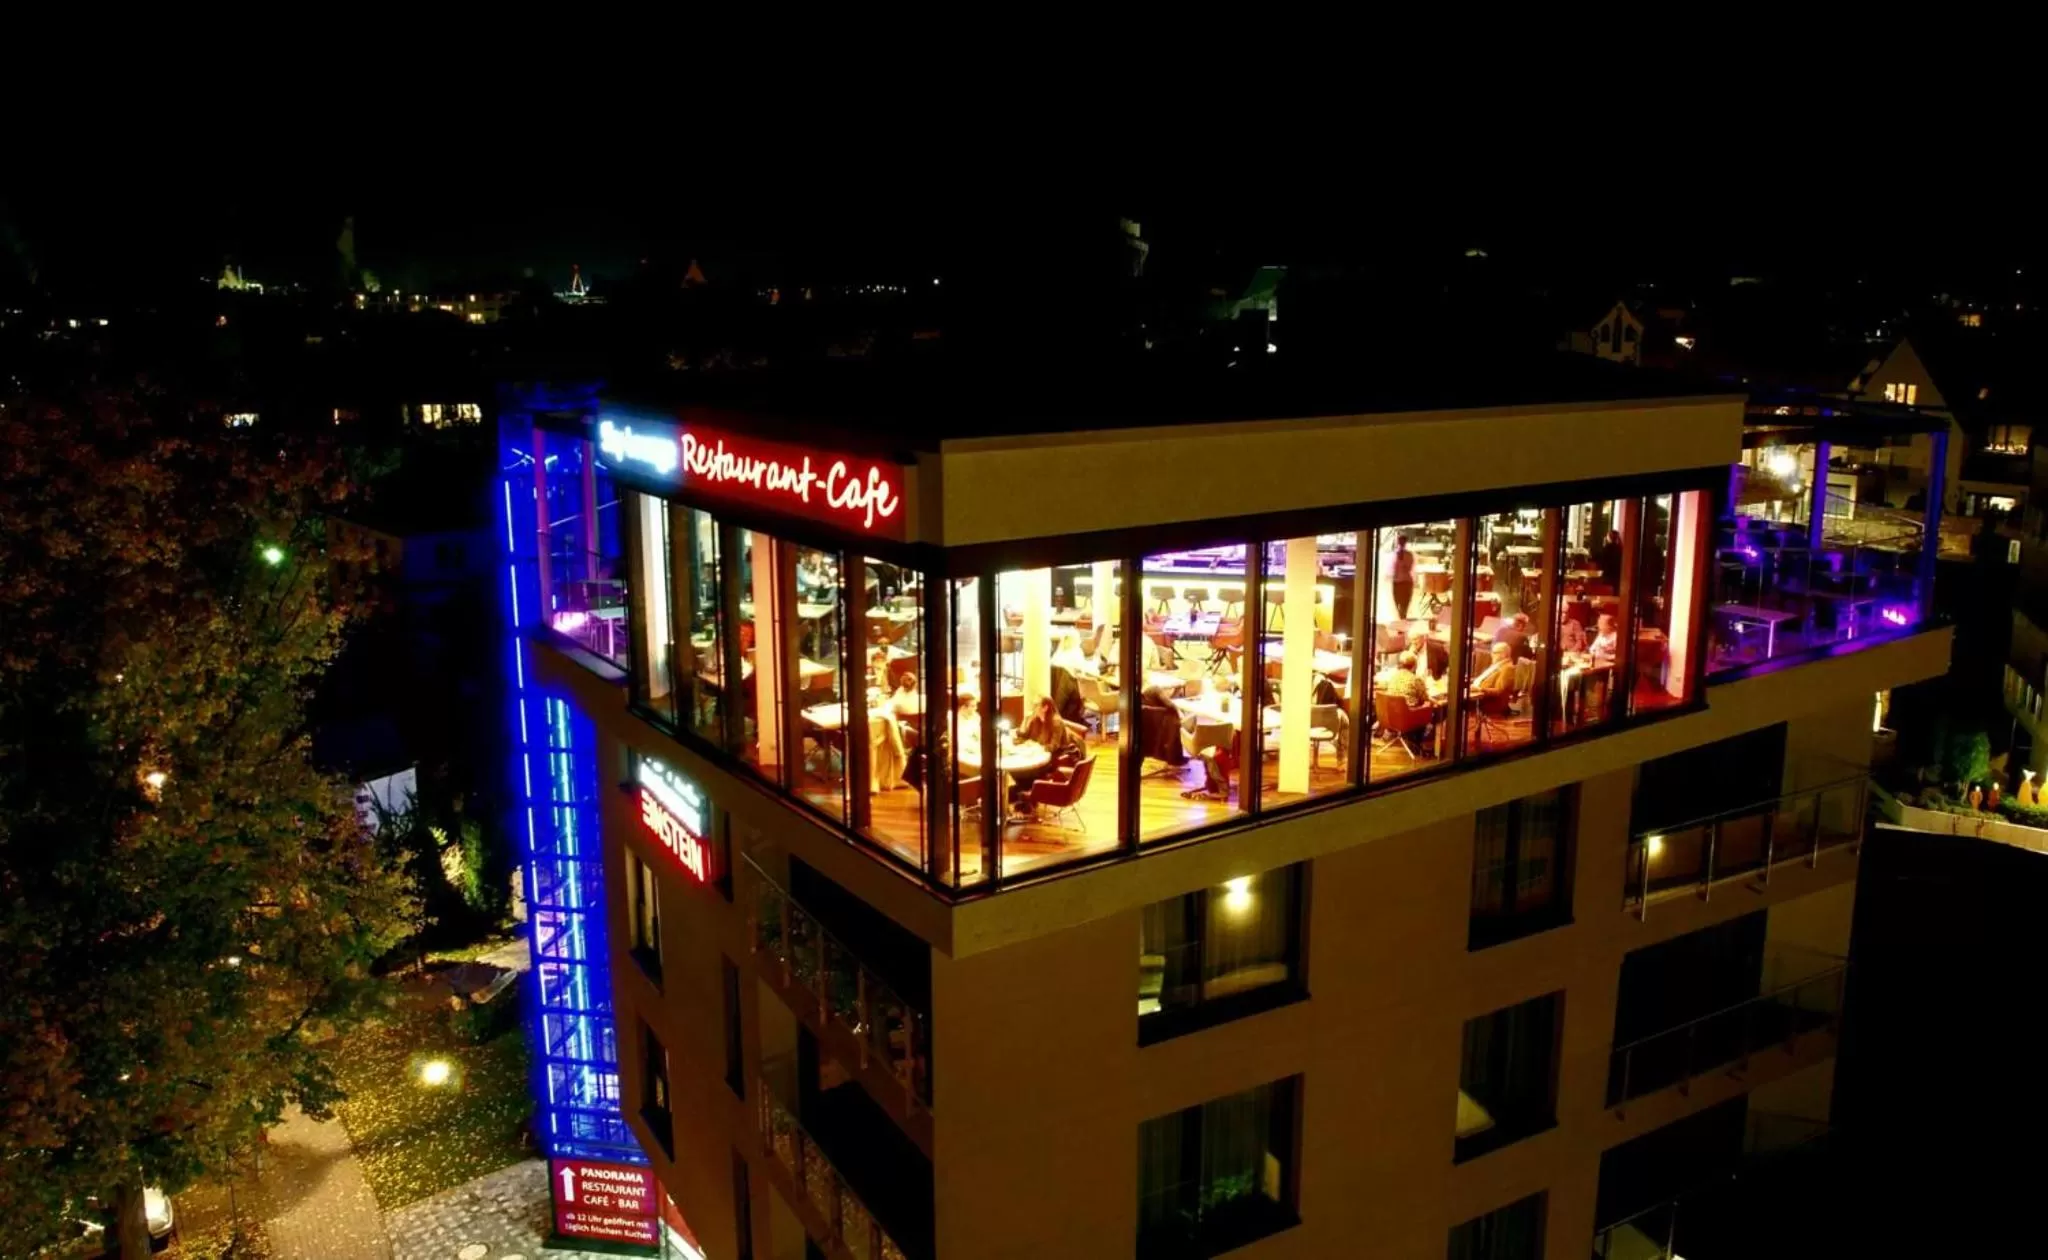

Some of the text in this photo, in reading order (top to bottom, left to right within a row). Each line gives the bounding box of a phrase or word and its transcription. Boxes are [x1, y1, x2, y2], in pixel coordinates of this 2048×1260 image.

[580, 1167, 644, 1183] PANORAMA
[582, 1181, 647, 1197] RESTAURANT
[583, 1194, 639, 1209] CAFÉ BAR
[577, 1213, 587, 1221] 12
[588, 1214, 602, 1223] Uhr
[603, 1217, 635, 1227] geöffnet
[565, 1223, 590, 1233] täglich
